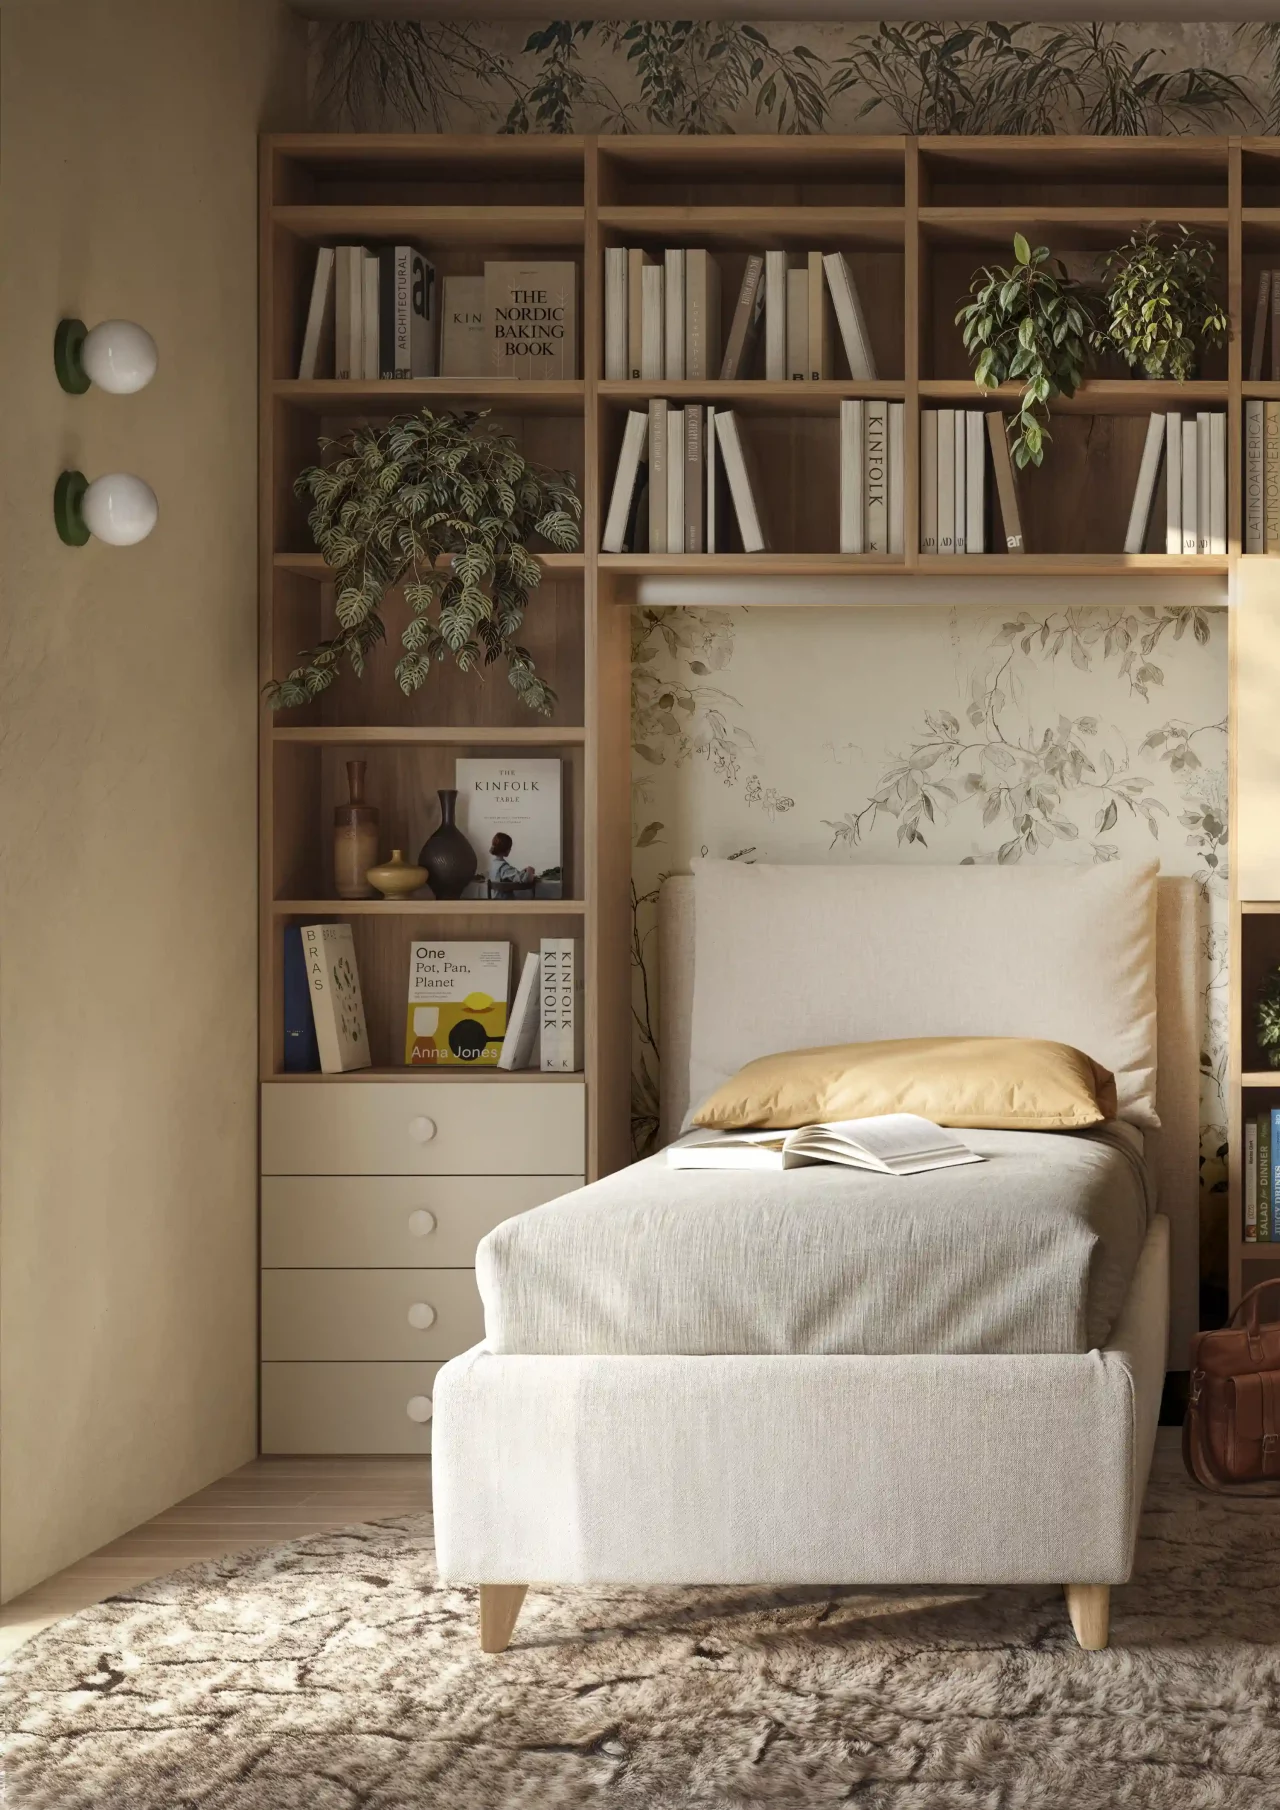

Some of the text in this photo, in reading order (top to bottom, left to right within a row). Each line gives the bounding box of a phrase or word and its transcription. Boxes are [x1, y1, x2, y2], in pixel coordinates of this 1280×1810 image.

[413, 256, 435, 321] ar
[398, 255, 407, 350] ARCHITECTURAL
[511, 290, 547, 304] THE
[495, 307, 565, 321] NORDIC
[495, 324, 565, 339] BAKING
[505, 342, 555, 356] BOOK
[632, 369, 641, 379] B
[812, 372, 820, 381] B
[868, 416, 884, 507] KINFOLK
[1248, 413, 1261, 540] LATINOAMERICA
[1266, 414, 1279, 541] LATINOAMERICA
[870, 542, 878, 551] K
[1006, 535, 1023, 548] ar
[475, 781, 540, 791] KINFOLK
[416, 947, 446, 959] One
[306, 930, 324, 991] BRAS
[416, 962, 471, 974] Pot, Pan,
[415, 977, 454, 988] Planet
[544, 951, 557, 1030] KINFOLK
[561, 951, 572, 1030] KINFOLK
[411, 1045, 498, 1059] Anna Jones
[1260, 1145, 1268, 1186] DINNER
[1260, 1203, 1268, 1236] SALAD
